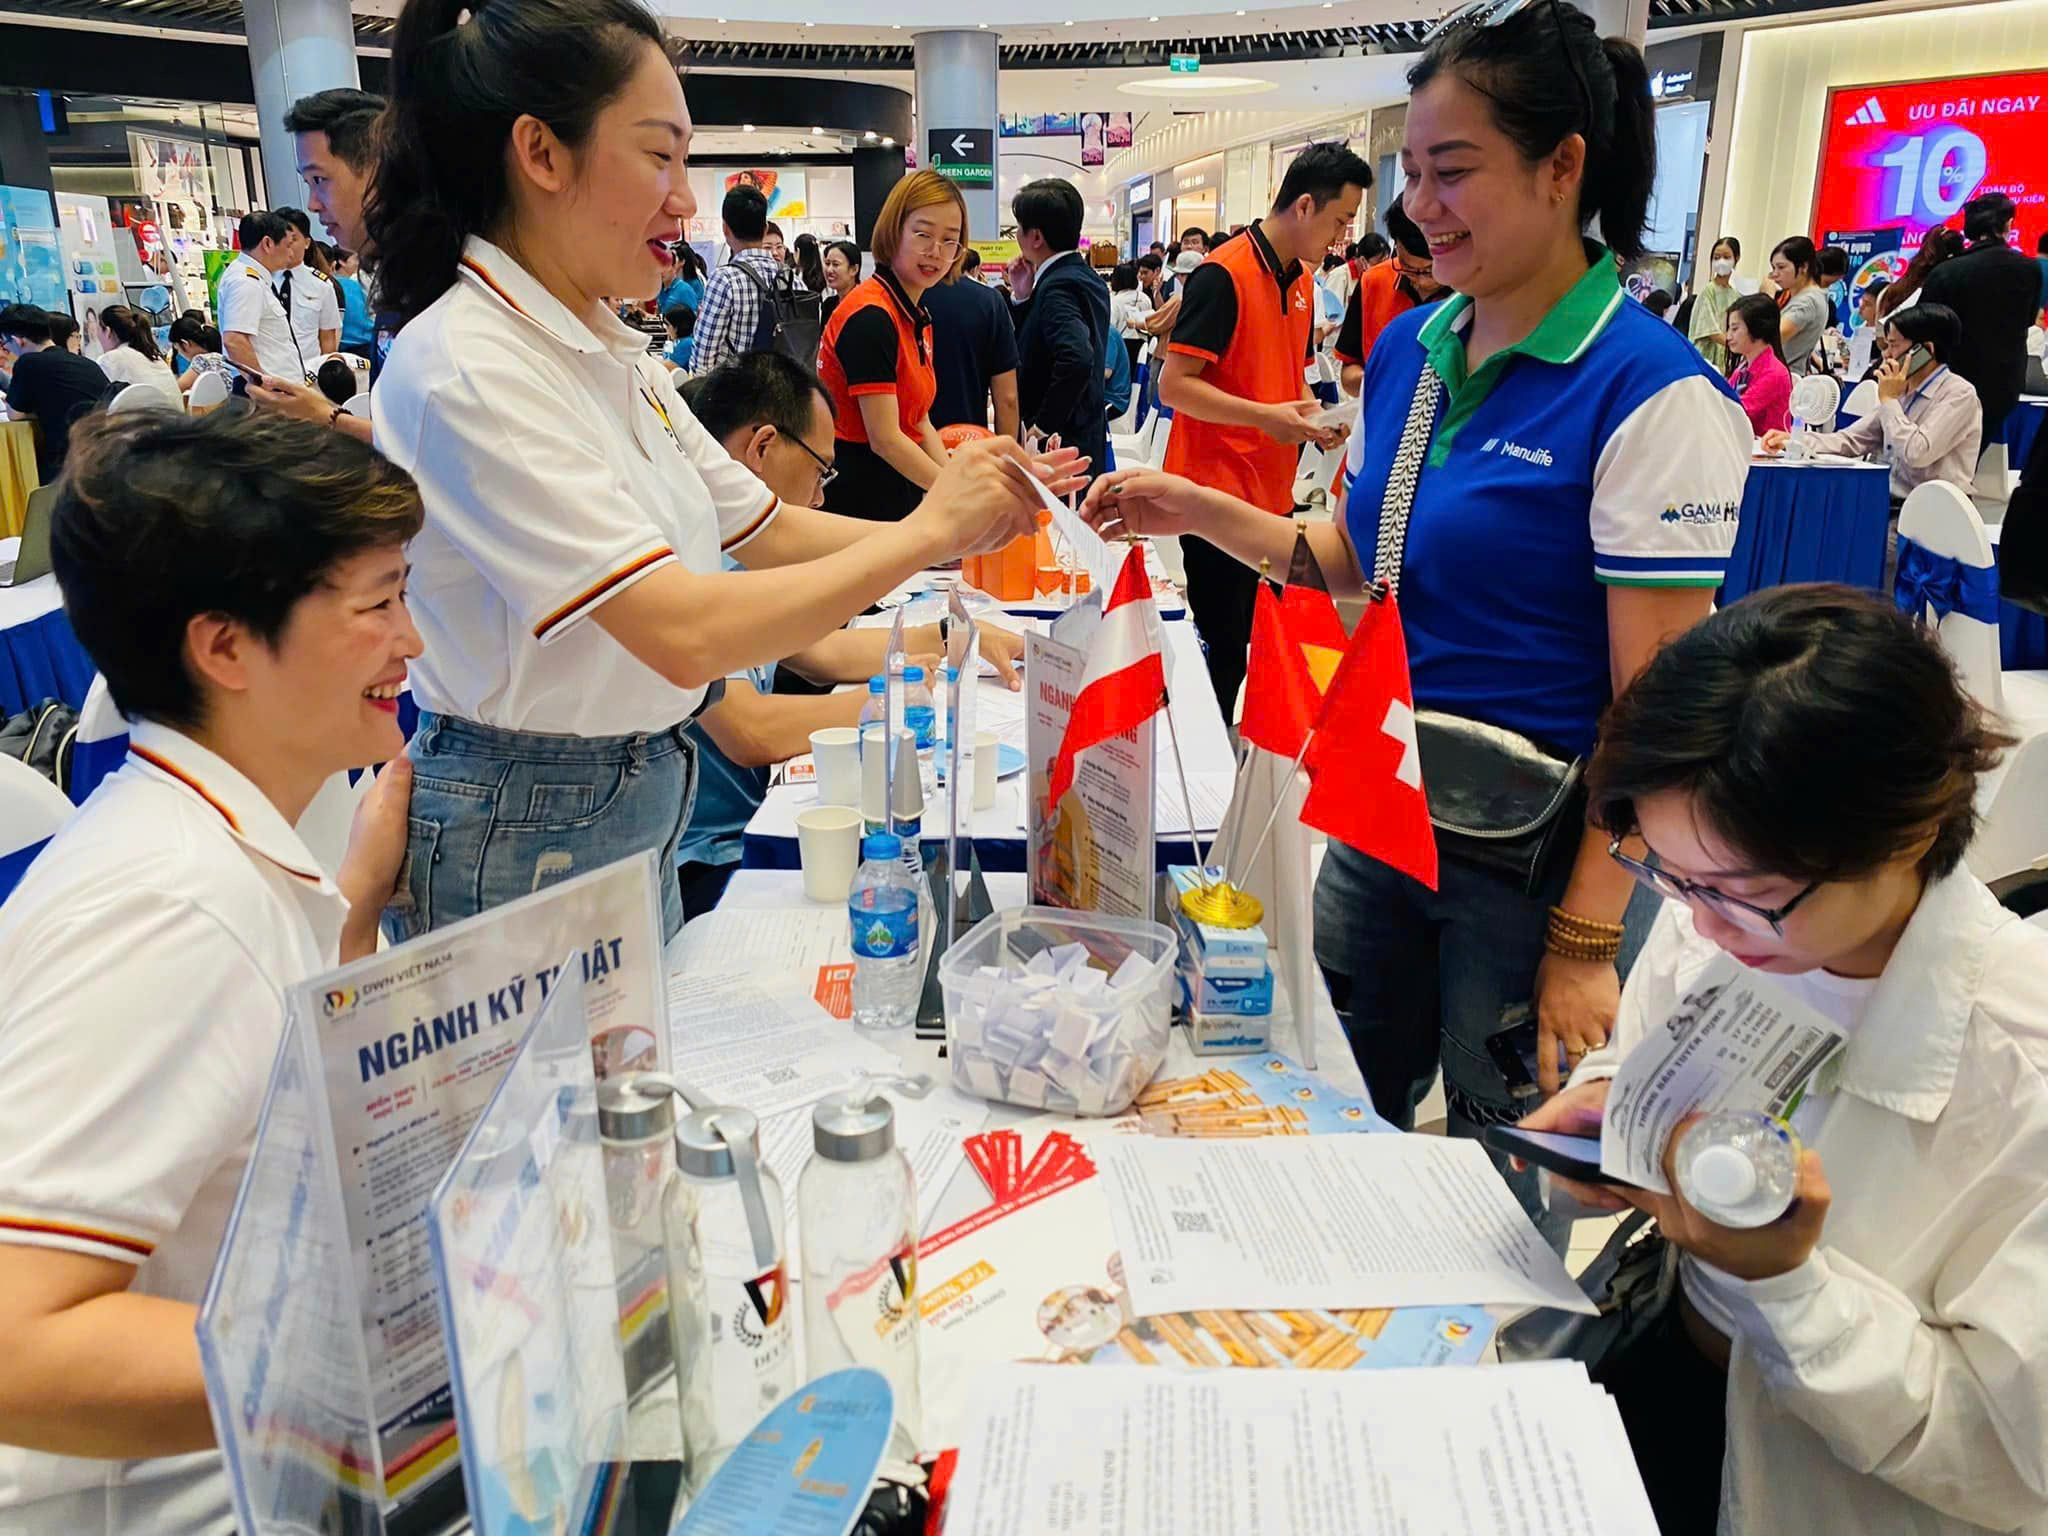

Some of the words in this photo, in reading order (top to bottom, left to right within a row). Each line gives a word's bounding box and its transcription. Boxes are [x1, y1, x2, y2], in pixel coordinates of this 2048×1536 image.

[1981, 96, 2041, 114] NGAY
[964, 168, 993, 177] GARDEN
[1883, 130, 1986, 216] 10
[1500, 440, 1553, 467] Manulife
[1681, 503, 1722, 519] GAMA
[358, 1001, 479, 1083] NGÀNH
[488, 974, 526, 1026] KỸ
